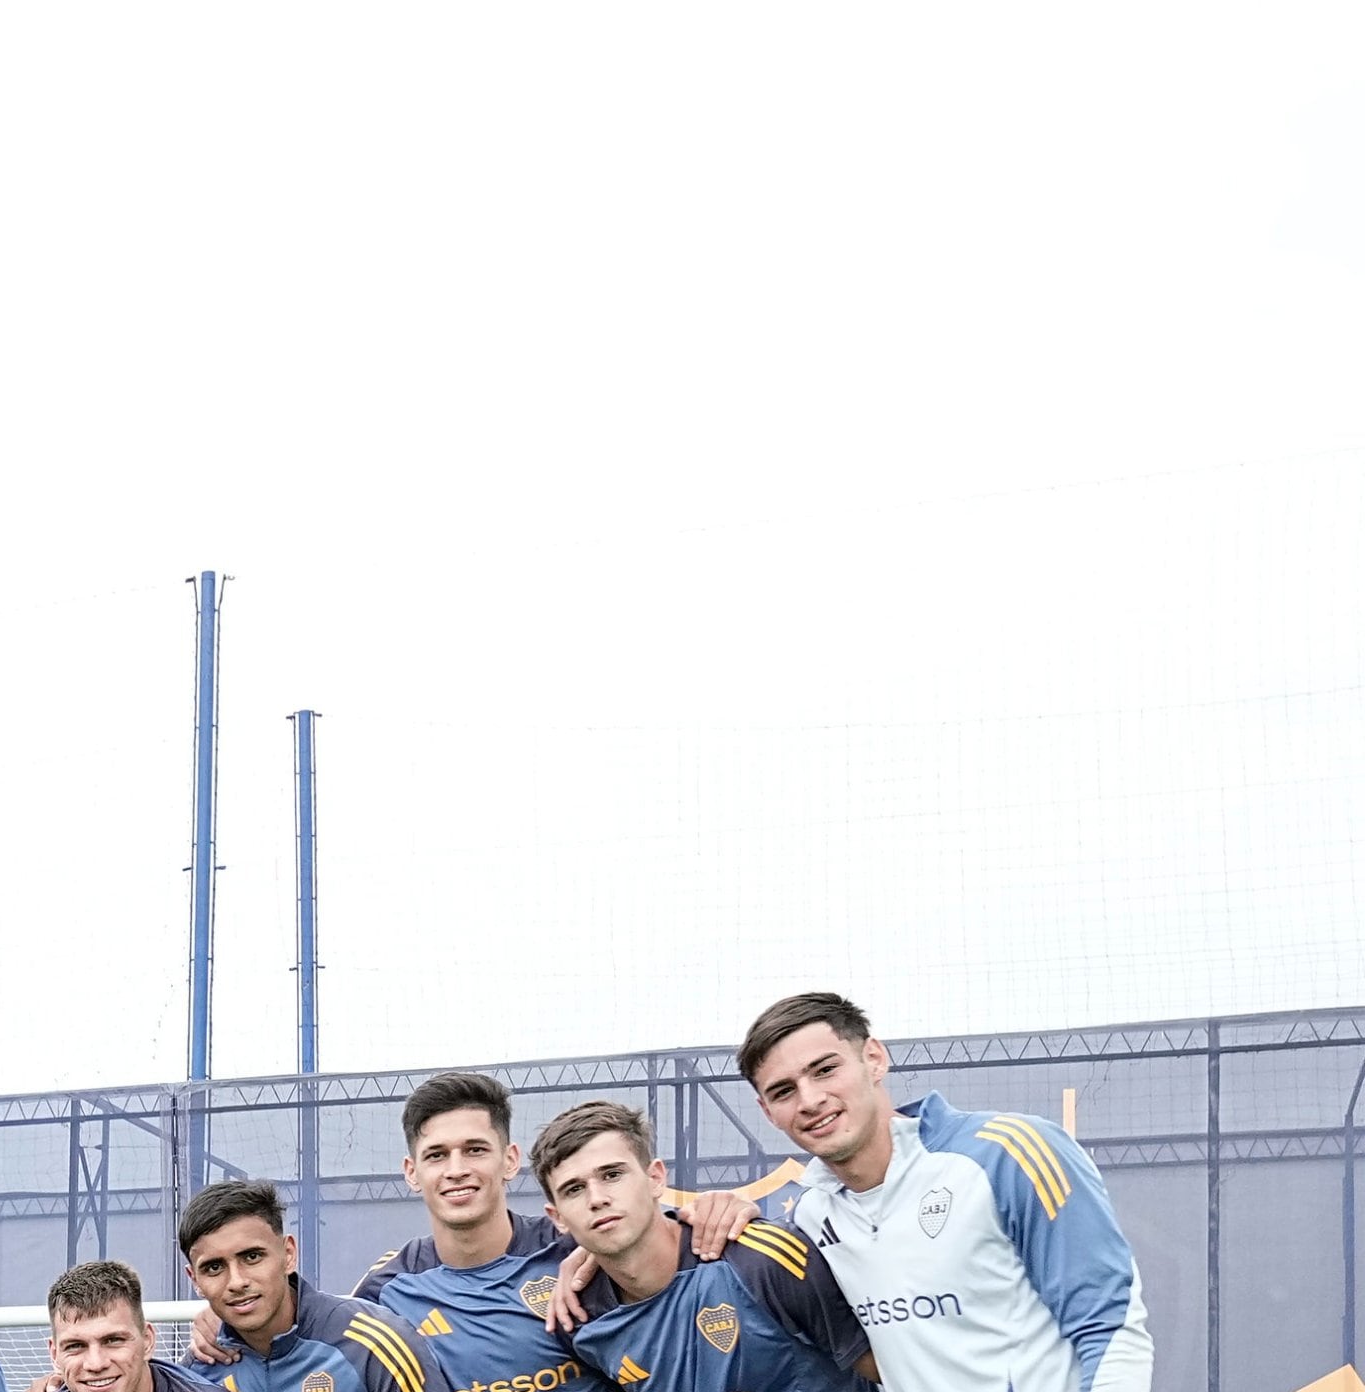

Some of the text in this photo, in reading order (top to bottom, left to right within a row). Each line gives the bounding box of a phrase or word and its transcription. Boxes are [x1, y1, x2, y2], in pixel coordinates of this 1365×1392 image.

[921, 1203, 948, 1216] CABJ
[853, 1292, 963, 1327] etsson
[705, 1319, 735, 1333] CABJ
